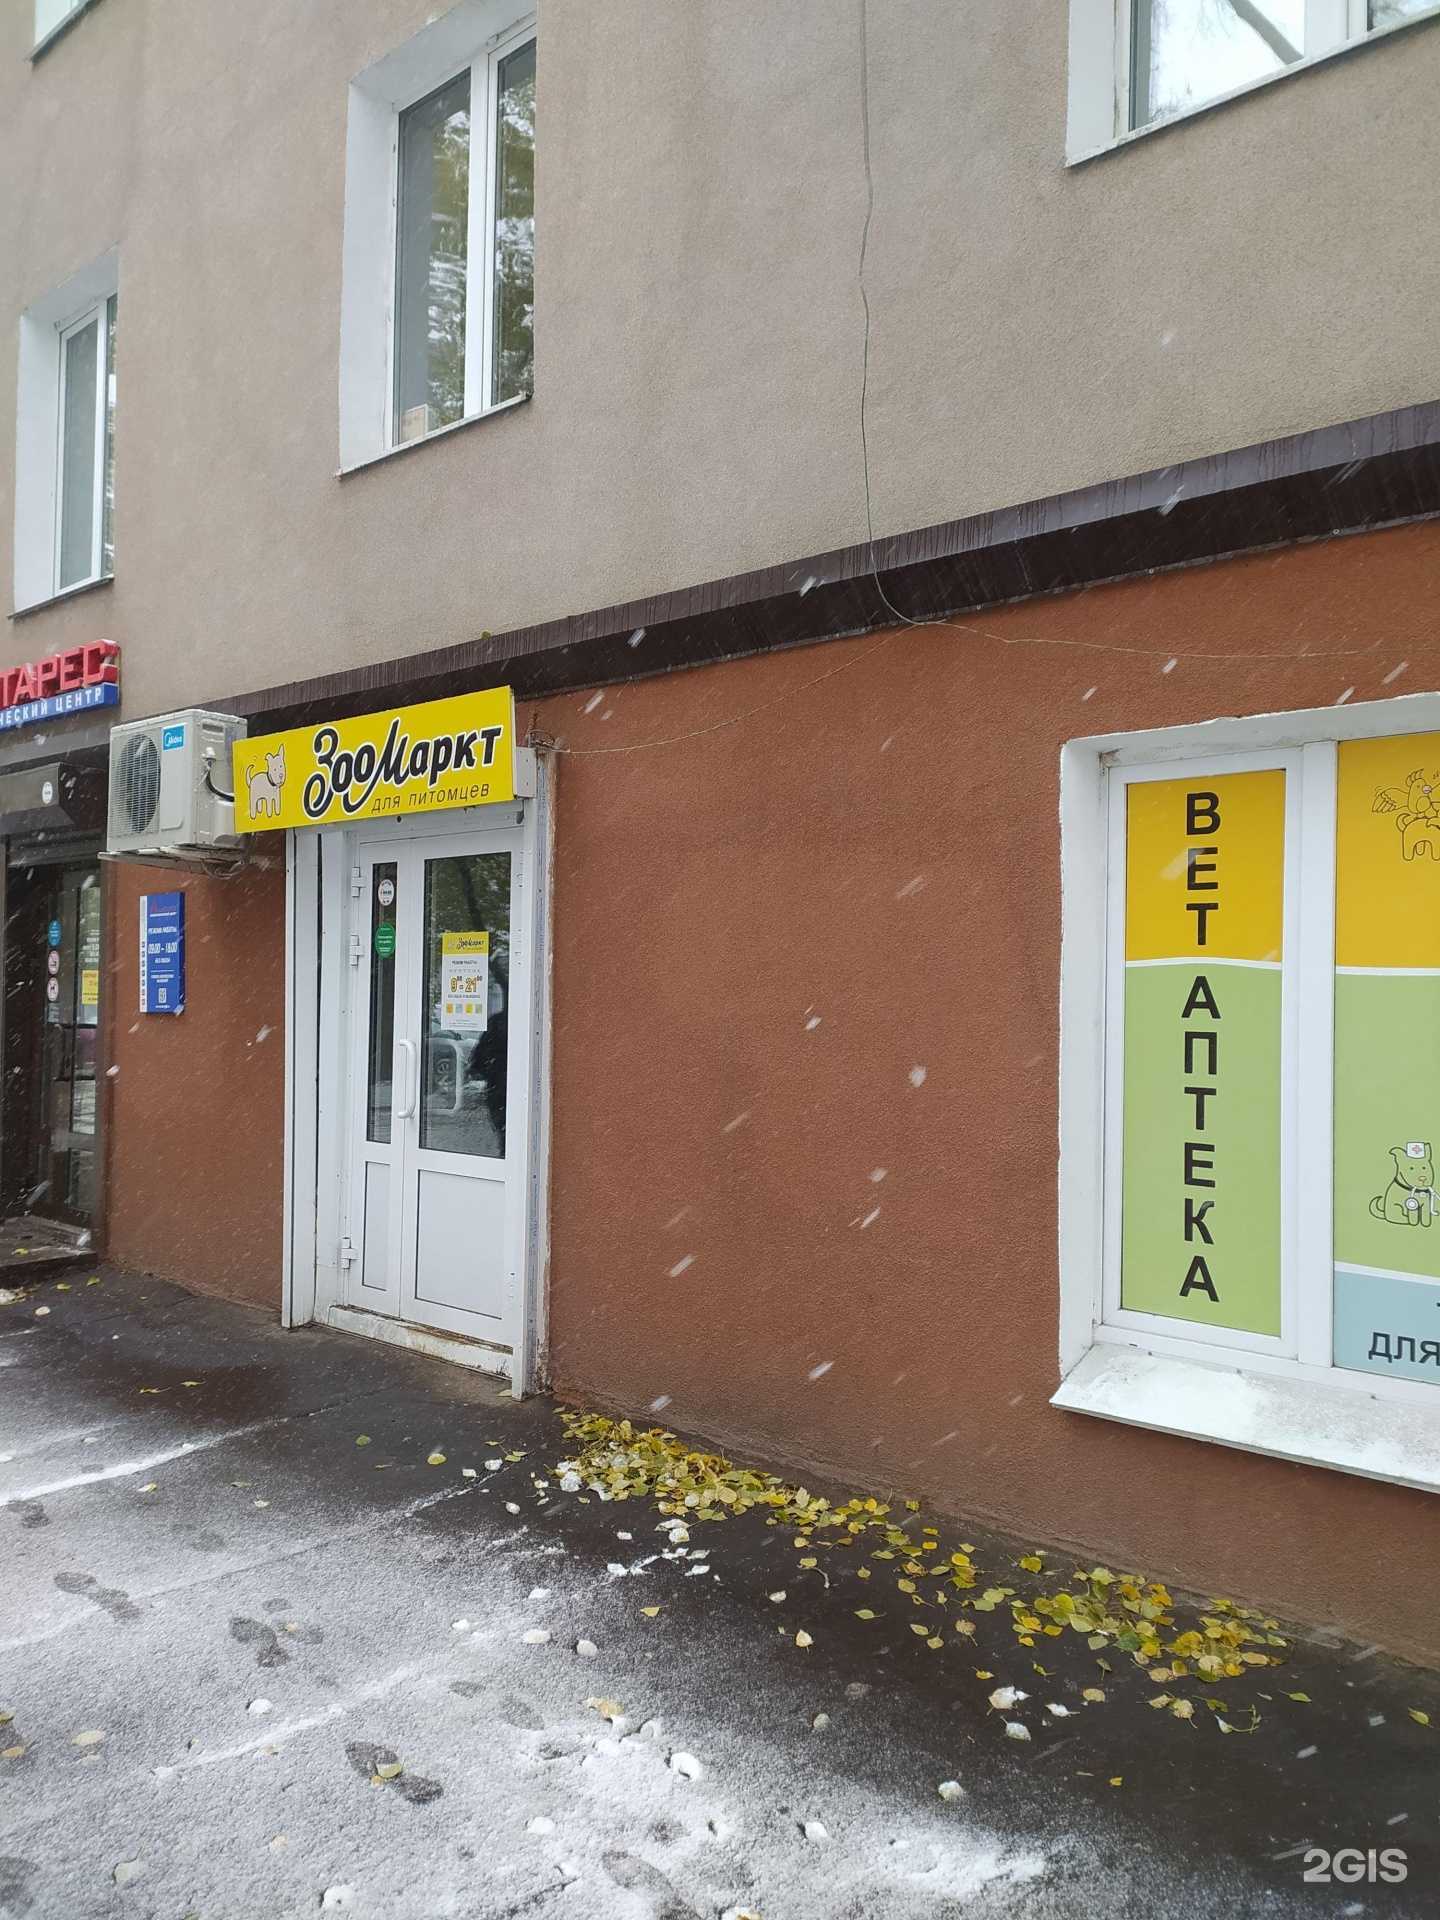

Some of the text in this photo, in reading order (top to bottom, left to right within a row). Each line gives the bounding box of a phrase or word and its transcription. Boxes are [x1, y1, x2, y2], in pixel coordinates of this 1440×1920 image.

[55, 687, 102, 712] ЦЕНТР
[371, 783, 490, 815] для питомцев
